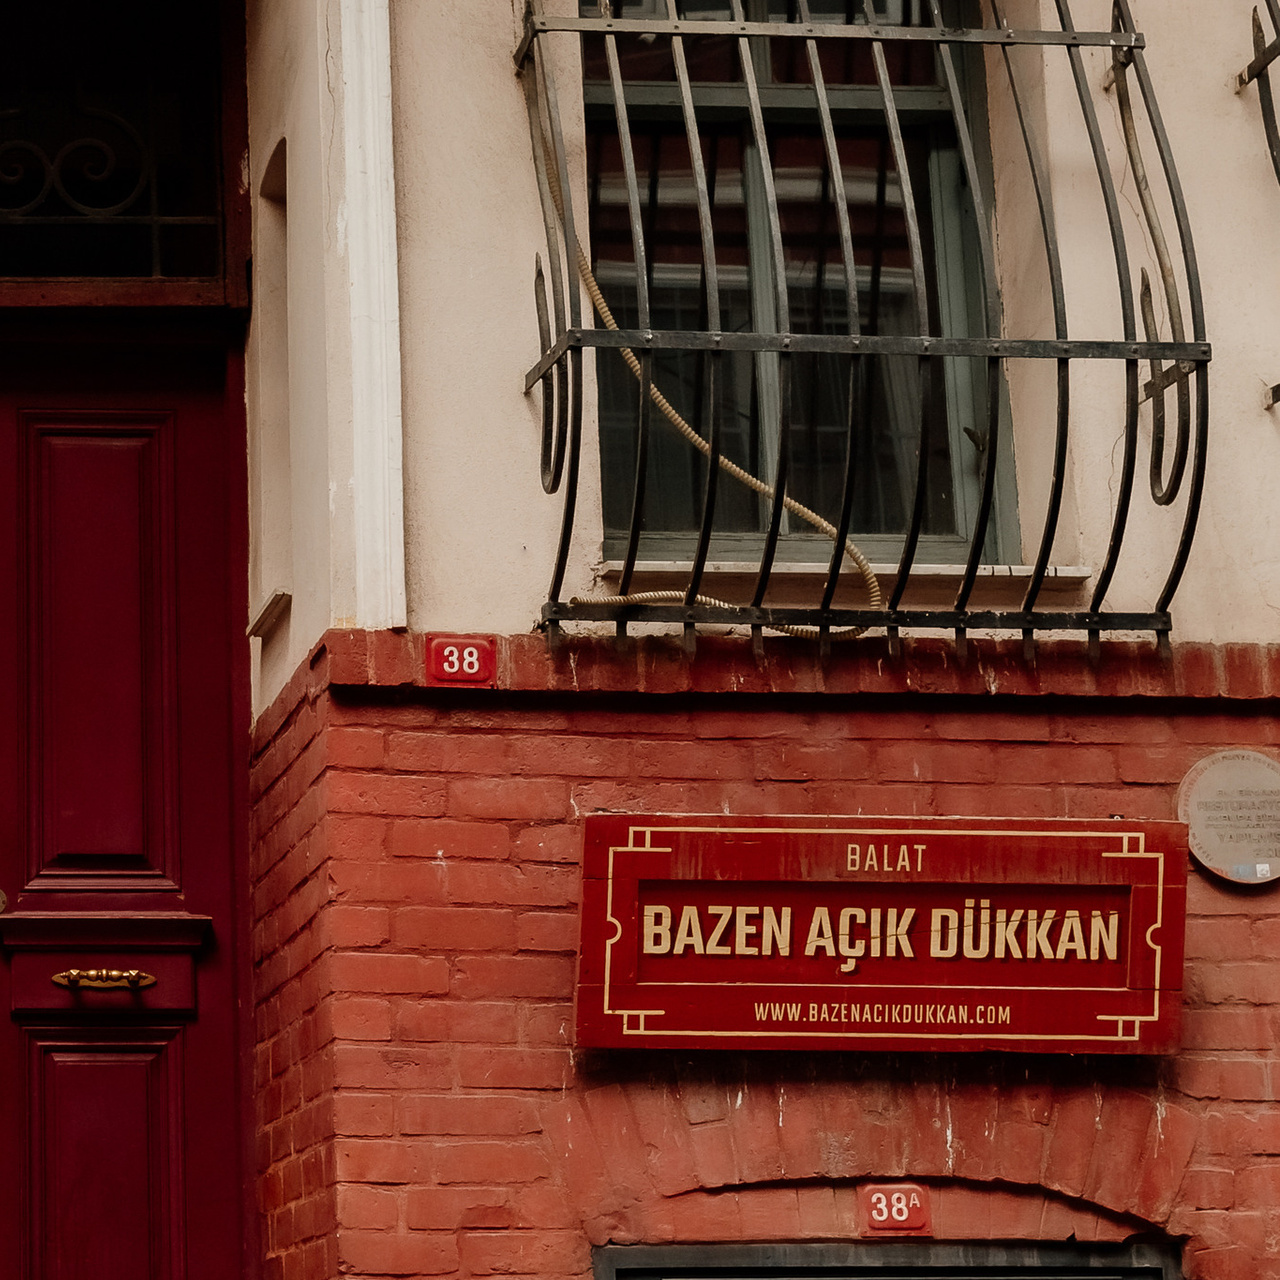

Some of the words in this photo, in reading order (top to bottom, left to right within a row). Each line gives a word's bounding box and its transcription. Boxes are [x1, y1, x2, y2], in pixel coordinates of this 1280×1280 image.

[443, 646, 480, 674] 38
[847, 843, 927, 872] BALAT
[642, 905, 792, 956] BAZEN
[804, 906, 916, 972] AÇIK
[930, 899, 1119, 960] DÜKKAN
[754, 1002, 1011, 1025] WWW.BAZENACIKDUKKAN.COM
[871, 1192, 921, 1222] 38A
